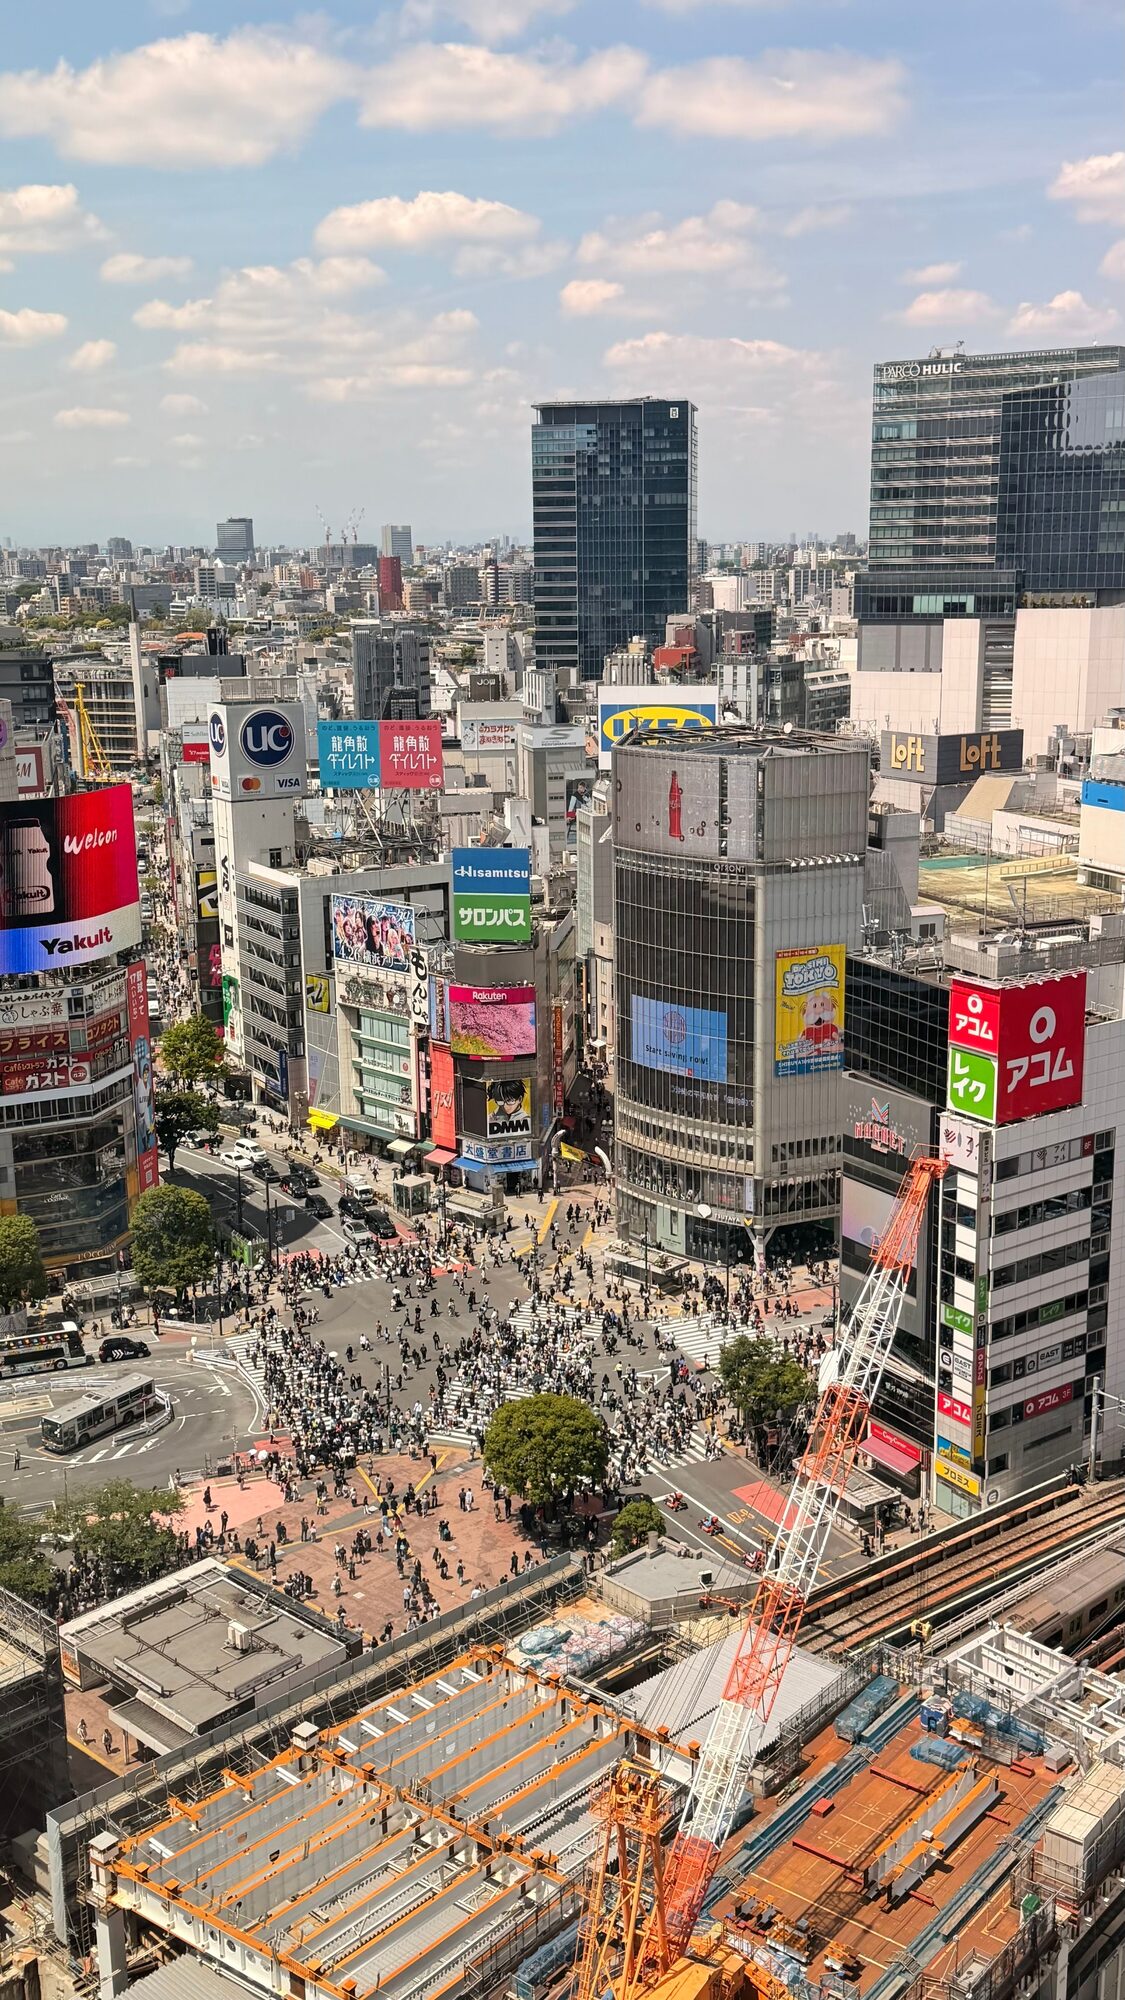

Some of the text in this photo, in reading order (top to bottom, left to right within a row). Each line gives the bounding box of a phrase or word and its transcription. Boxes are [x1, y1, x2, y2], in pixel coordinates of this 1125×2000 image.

[882, 362, 962, 378] PARCO HULIC
[331, 736, 368, 752] 龍角散
[393, 736, 430, 752] 龍角散
[278, 778, 300, 788] VISA
[455, 865, 529, 878] Hisamitsu
[459, 907, 526, 927] サロンパス
[39, 926, 113, 955] Yakult
[785, 966, 837, 987] TOKYO
[472, 991, 507, 1000] Rakuten
[87, 1018, 120, 1040] コンタクト
[956, 1013, 993, 1040] アコム
[645, 1044, 662, 1056] Start
[46, 1055, 78, 1069] ガスト
[1007, 1047, 1074, 1094] アコム
[26, 1071, 65, 1089] ガスト
[488, 1119, 530, 1135] DMM
[855, 1122, 906, 1156] MAGNET
[465, 1142, 527, 1159] 大盛堂書店
[771, 1170, 842, 1188] STARBUCKS
[946, 1309, 971, 1328] レイク
[1042, 1305, 1060, 1317] レイク
[1038, 1388, 1071, 1409] アコム 3F
[942, 1397, 971, 1421] アコム
[943, 1466, 970, 1488] プロミス
